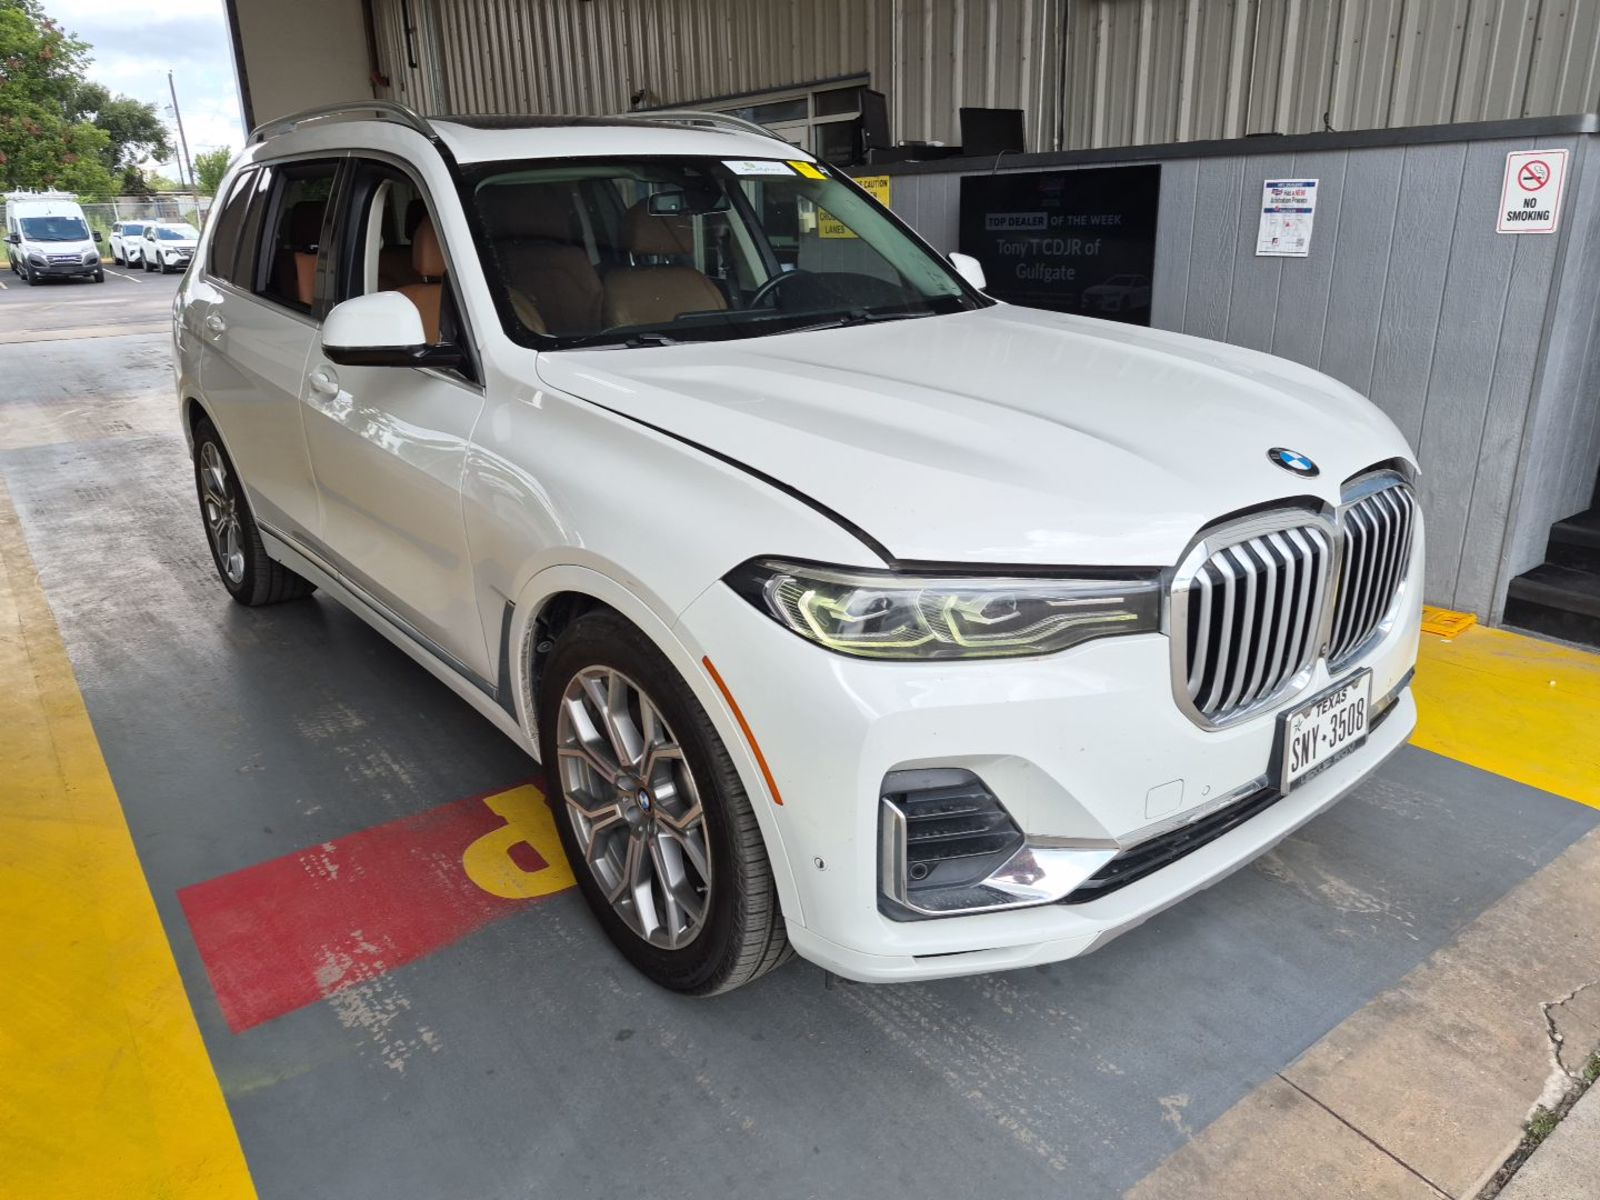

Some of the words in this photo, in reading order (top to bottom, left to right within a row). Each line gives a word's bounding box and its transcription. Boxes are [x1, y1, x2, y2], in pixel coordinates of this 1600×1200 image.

[864, 179, 887, 188] CAUTION
[1523, 197, 1537, 208] NO
[989, 217, 1007, 226] TOP
[1008, 216, 1044, 226] DEALER
[1051, 216, 1064, 225] OF
[1067, 215, 1087, 225] THE
[1090, 214, 1122, 225] WEEK
[1507, 210, 1550, 221] SMOKING
[825, 225, 845, 233] LANES
[997, 239, 1027, 257] Tony
[1030, 239, 1040, 255] T
[1042, 238, 1082, 255] CDJR
[1085, 238, 1102, 255] of
[1015, 263, 1076, 281] Gulfgate
[1316, 688, 1347, 717] TEXAS
